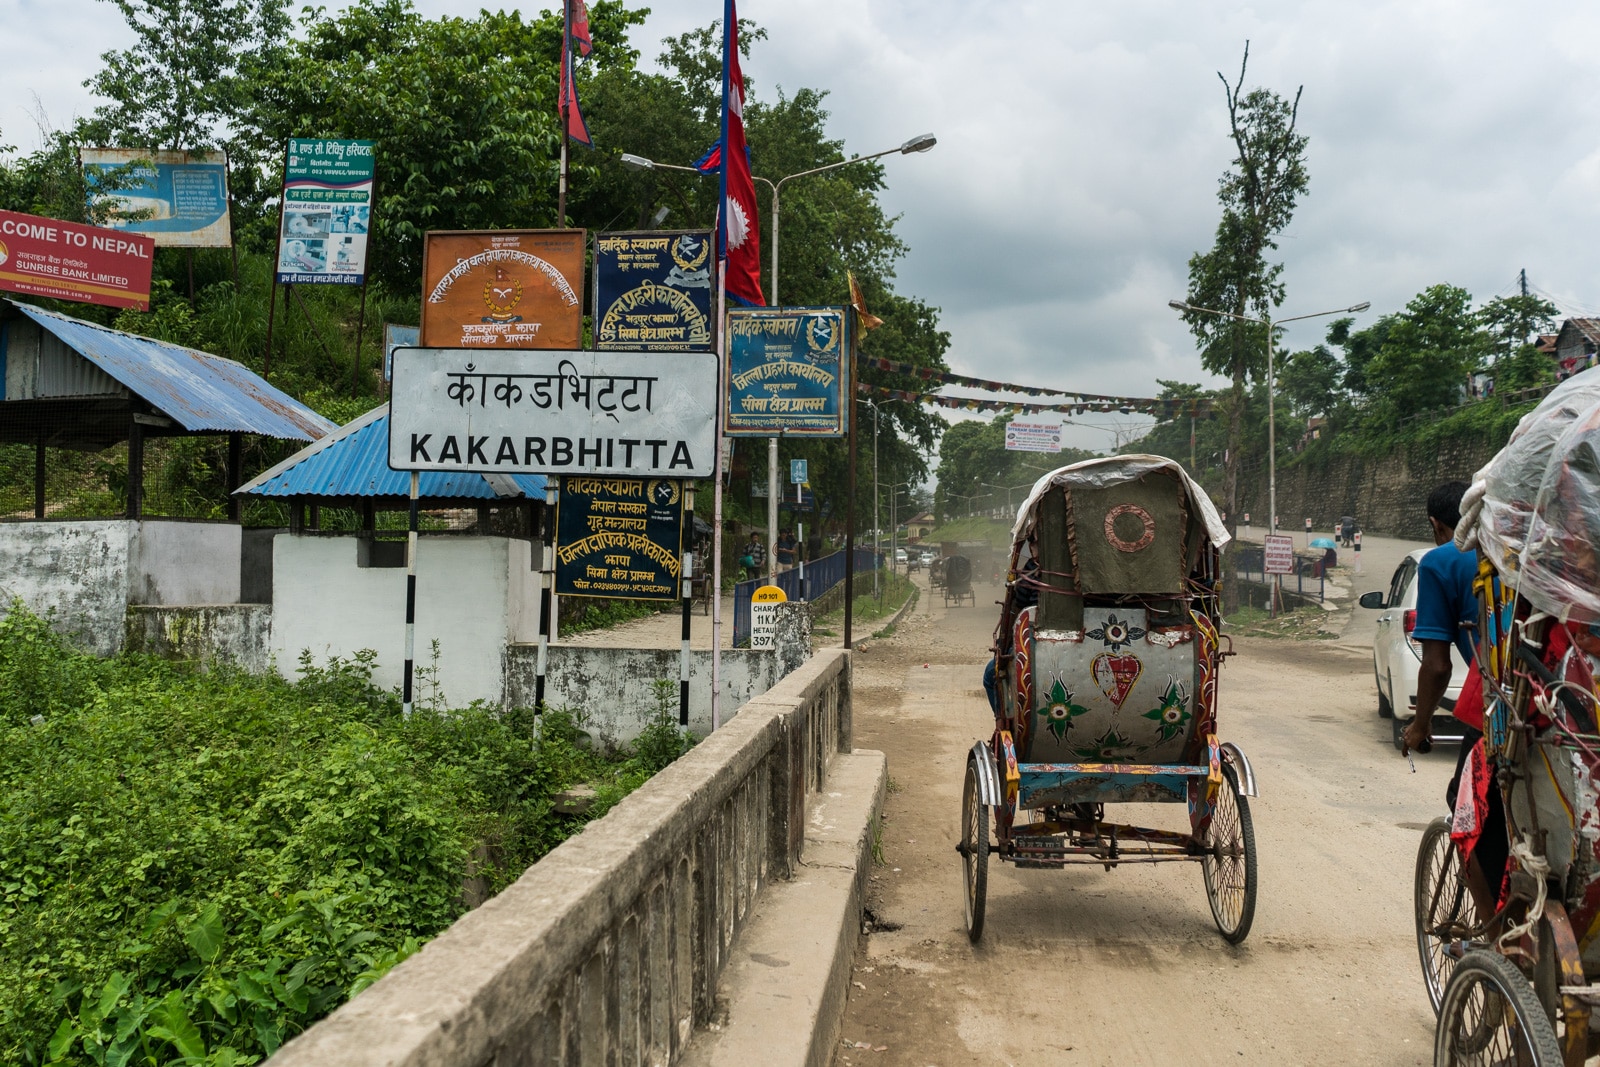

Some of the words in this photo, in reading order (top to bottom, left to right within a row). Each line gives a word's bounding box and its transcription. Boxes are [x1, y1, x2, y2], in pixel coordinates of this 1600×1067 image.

[62, 230, 87, 248] TO
[92, 235, 149, 259] NEPAL
[599, 236, 630, 255] हार्दिक
[631, 237, 670, 254] स्वागत
[16, 260, 59, 275] SUNRISE
[62, 267, 89, 280] BANK
[91, 272, 128, 286] LIMITED
[622, 278, 656, 311] प्रहरी
[515, 322, 541, 334] झापा
[446, 358, 660, 424] काँकडभिट्टा
[410, 433, 694, 470] KAKARBHITTA
[591, 497, 617, 513] नेपाल
[618, 502, 648, 516] सरकार
[587, 515, 603, 532] गृह
[604, 516, 648, 531] मन्त्रालय
[558, 543, 591, 566] जिल्ला
[626, 533, 650, 556] प्रहरी
[604, 554, 631, 567] झापा
[586, 564, 608, 579] सिमा
[611, 566, 629, 581] क्षेत्र
[629, 569, 656, 583] प्रारम्भ
